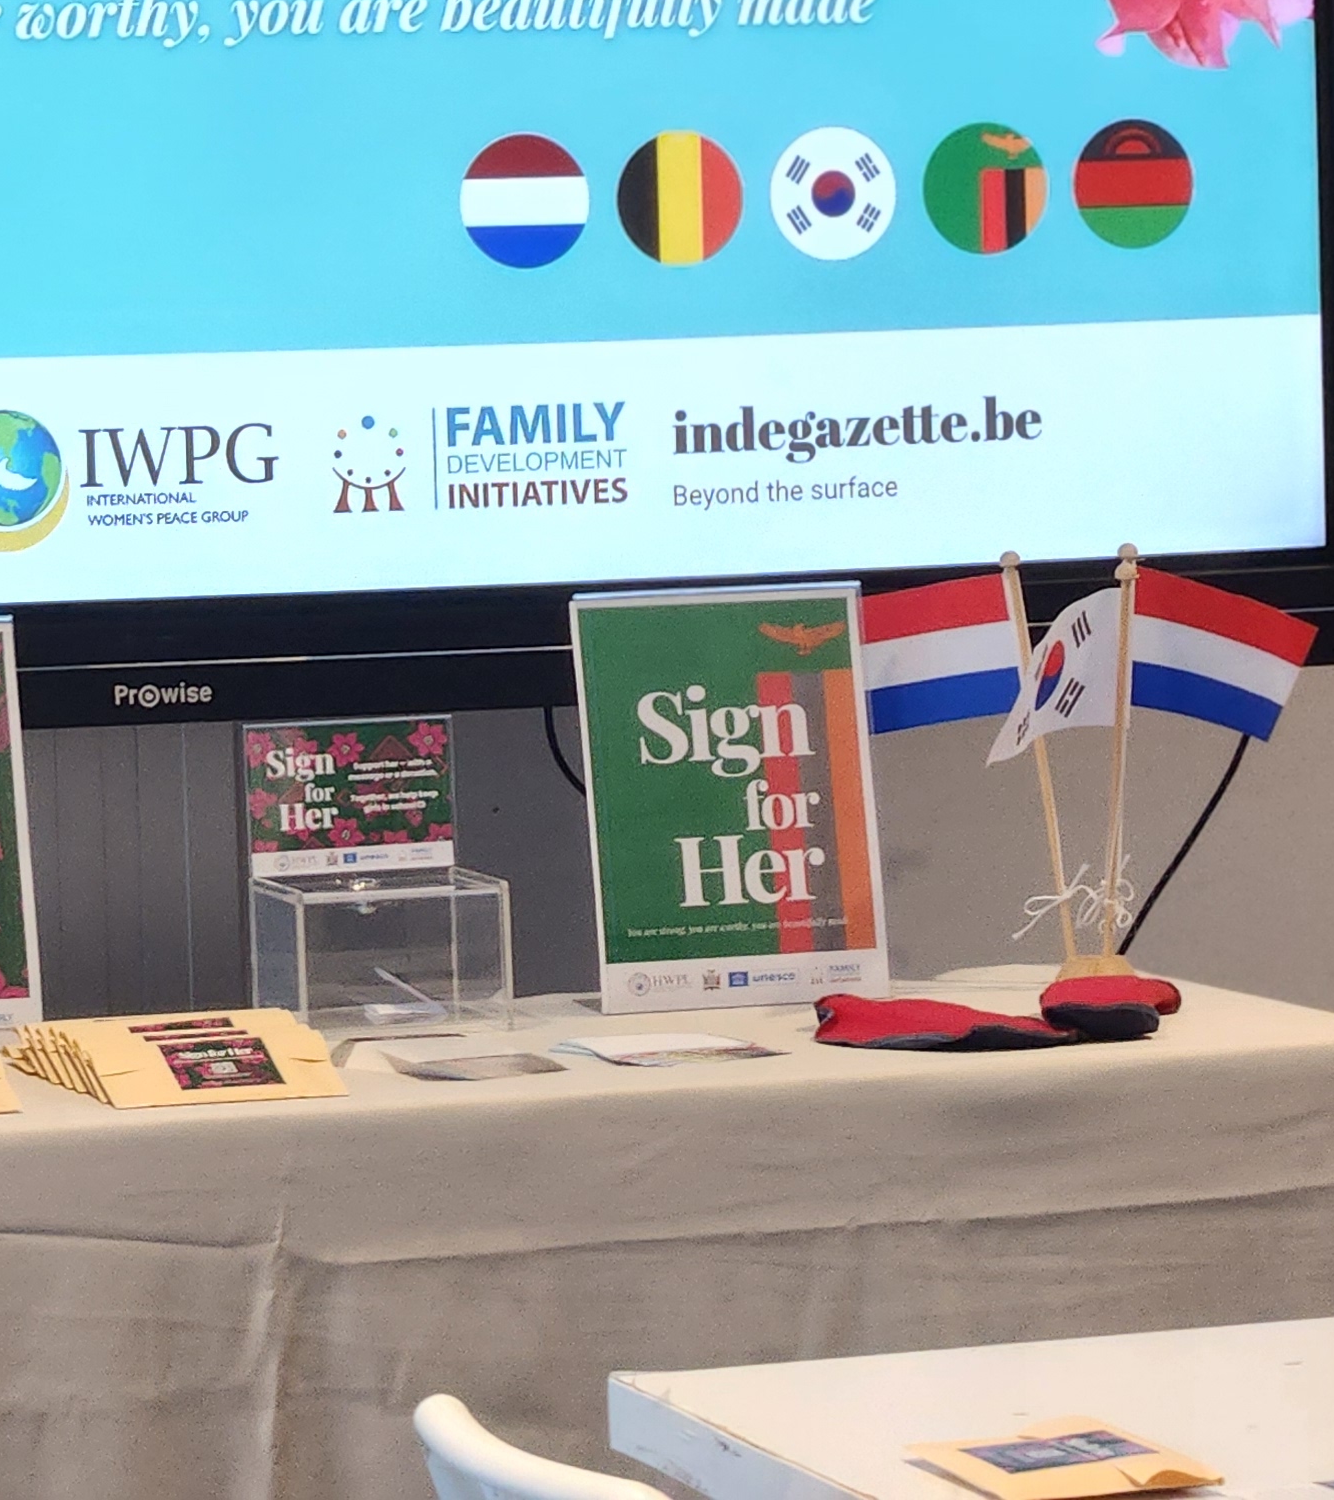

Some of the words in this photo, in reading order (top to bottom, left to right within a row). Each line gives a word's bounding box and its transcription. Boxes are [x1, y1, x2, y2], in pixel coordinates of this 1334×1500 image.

[446, 401, 626, 447] FAMILY
[672, 395, 1043, 463] indegazette.be
[78, 423, 280, 488] IWPG
[447, 449, 628, 474] DEVELOPMENT
[86, 491, 197, 507] INTERNATIONAL
[448, 477, 628, 510] INITIATIVES
[673, 481, 760, 511] Beyond
[765, 479, 804, 502] the
[810, 475, 899, 501] surface
[88, 513, 153, 526] WOMEN'S
[157, 511, 198, 525] PEACE
[201, 510, 249, 523] GROUP
[636, 684, 816, 778] Sign
[265, 748, 336, 782] Sign
[304, 782, 336, 804] for
[743, 779, 821, 833] for
[279, 803, 340, 832] Her
[674, 834, 826, 908] Her
